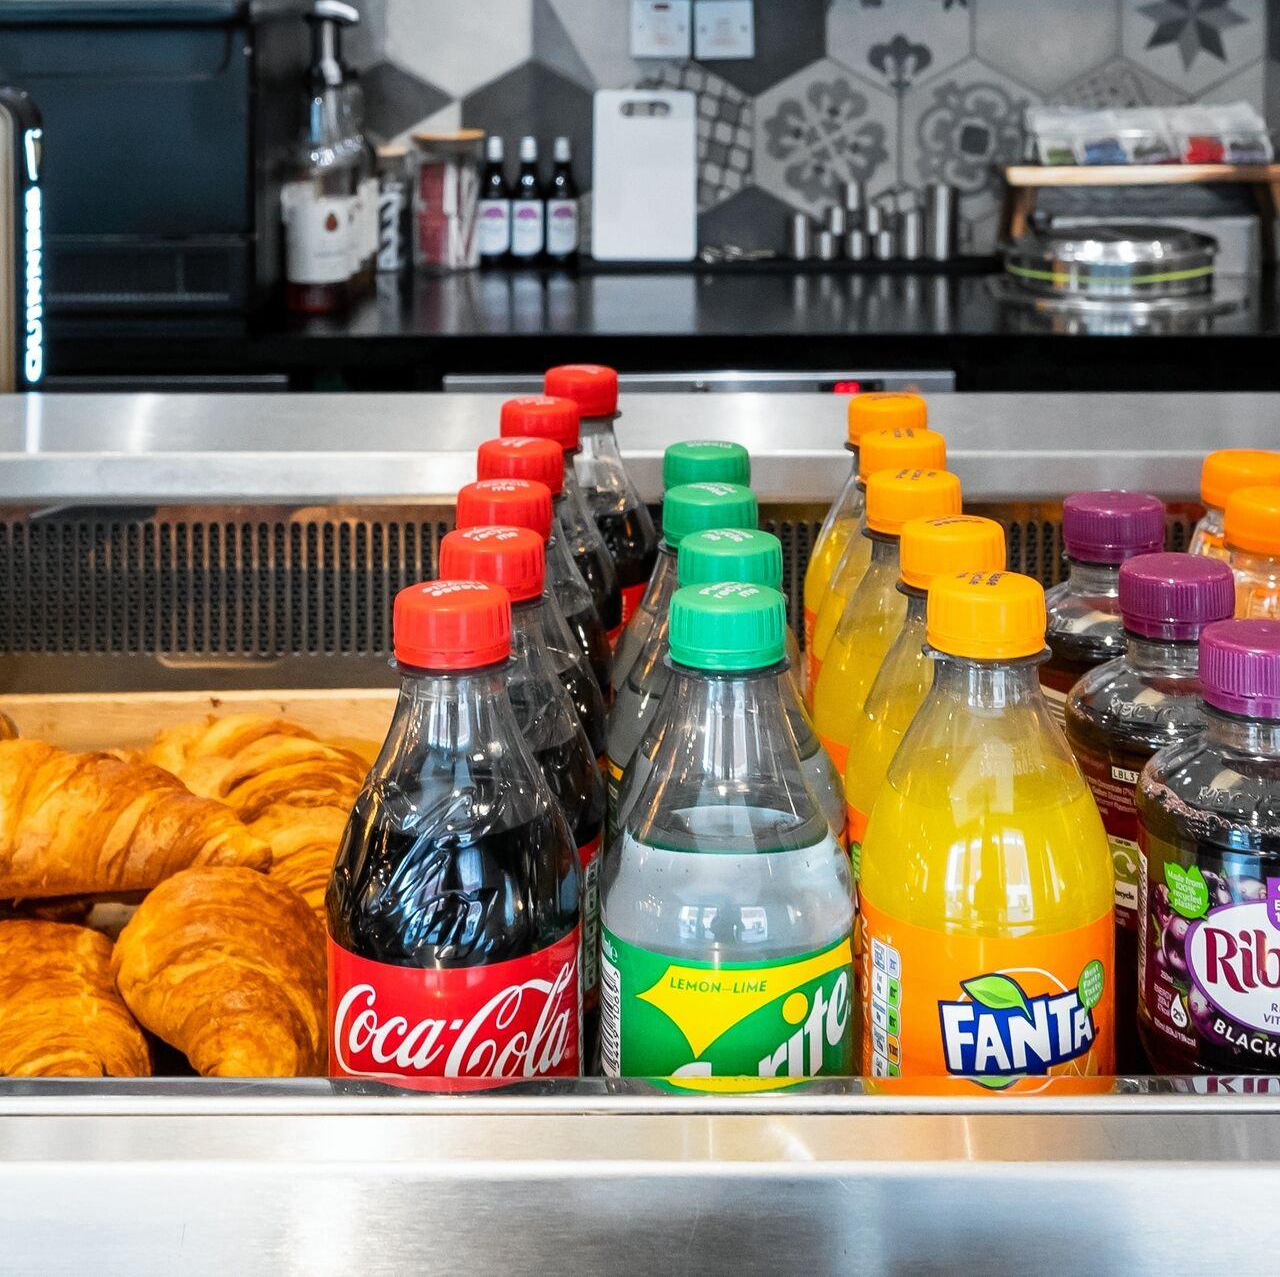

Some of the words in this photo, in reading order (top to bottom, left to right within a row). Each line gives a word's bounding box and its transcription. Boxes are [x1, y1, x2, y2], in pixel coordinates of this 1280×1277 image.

[334, 962, 572, 1077] Coca-Cola
[671, 970, 849, 1077] rite
[942, 992, 1094, 1072] FANTA
